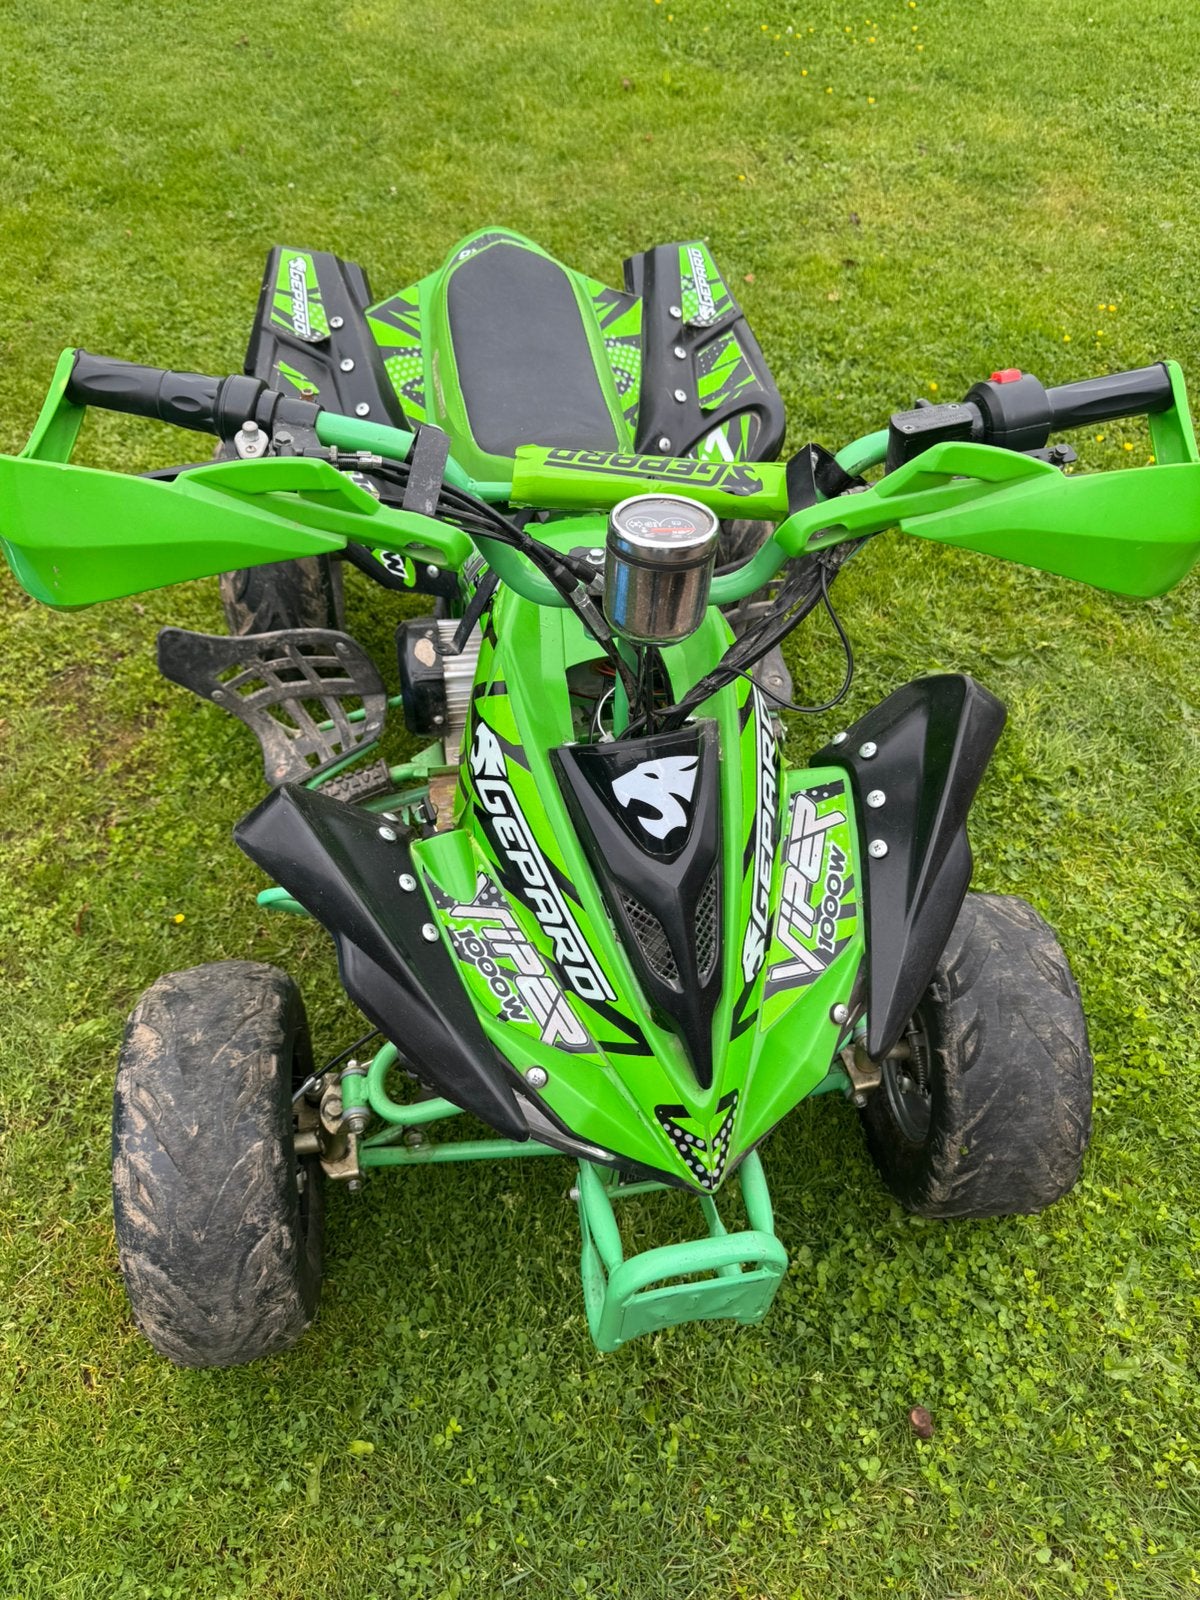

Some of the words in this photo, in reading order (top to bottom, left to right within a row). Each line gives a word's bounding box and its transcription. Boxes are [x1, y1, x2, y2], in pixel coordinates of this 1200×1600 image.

[289, 268, 311, 336] GEPARD
[686, 246, 715, 306] GEPARD
[543, 448, 723, 488] GEPARD
[475, 779, 617, 1002] GEPARD
[769, 793, 847, 982] VIPER
[817, 845, 847, 954] 1000W
[449, 872, 589, 1046] VIPER
[455, 928, 534, 1024] 1000W
